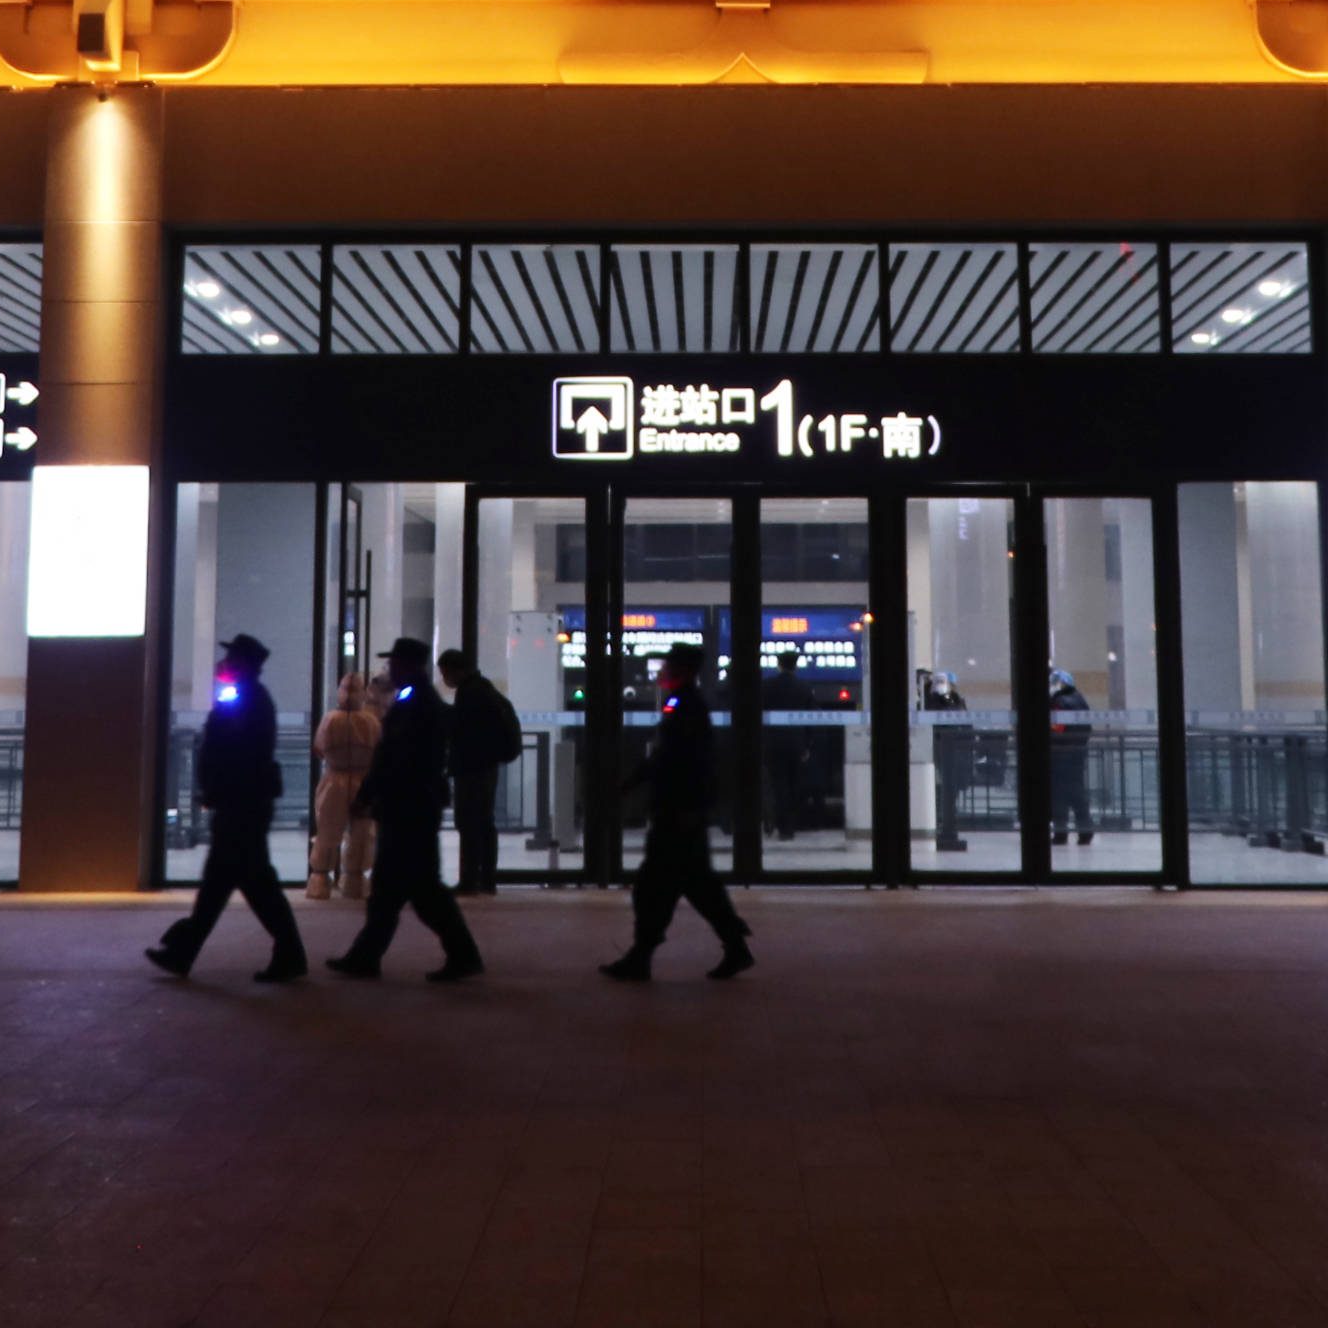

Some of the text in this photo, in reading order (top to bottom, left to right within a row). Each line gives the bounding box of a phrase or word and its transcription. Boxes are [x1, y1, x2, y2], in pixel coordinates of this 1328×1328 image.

[640, 384, 756, 426] 进站口
[639, 428, 741, 453] Entrance
